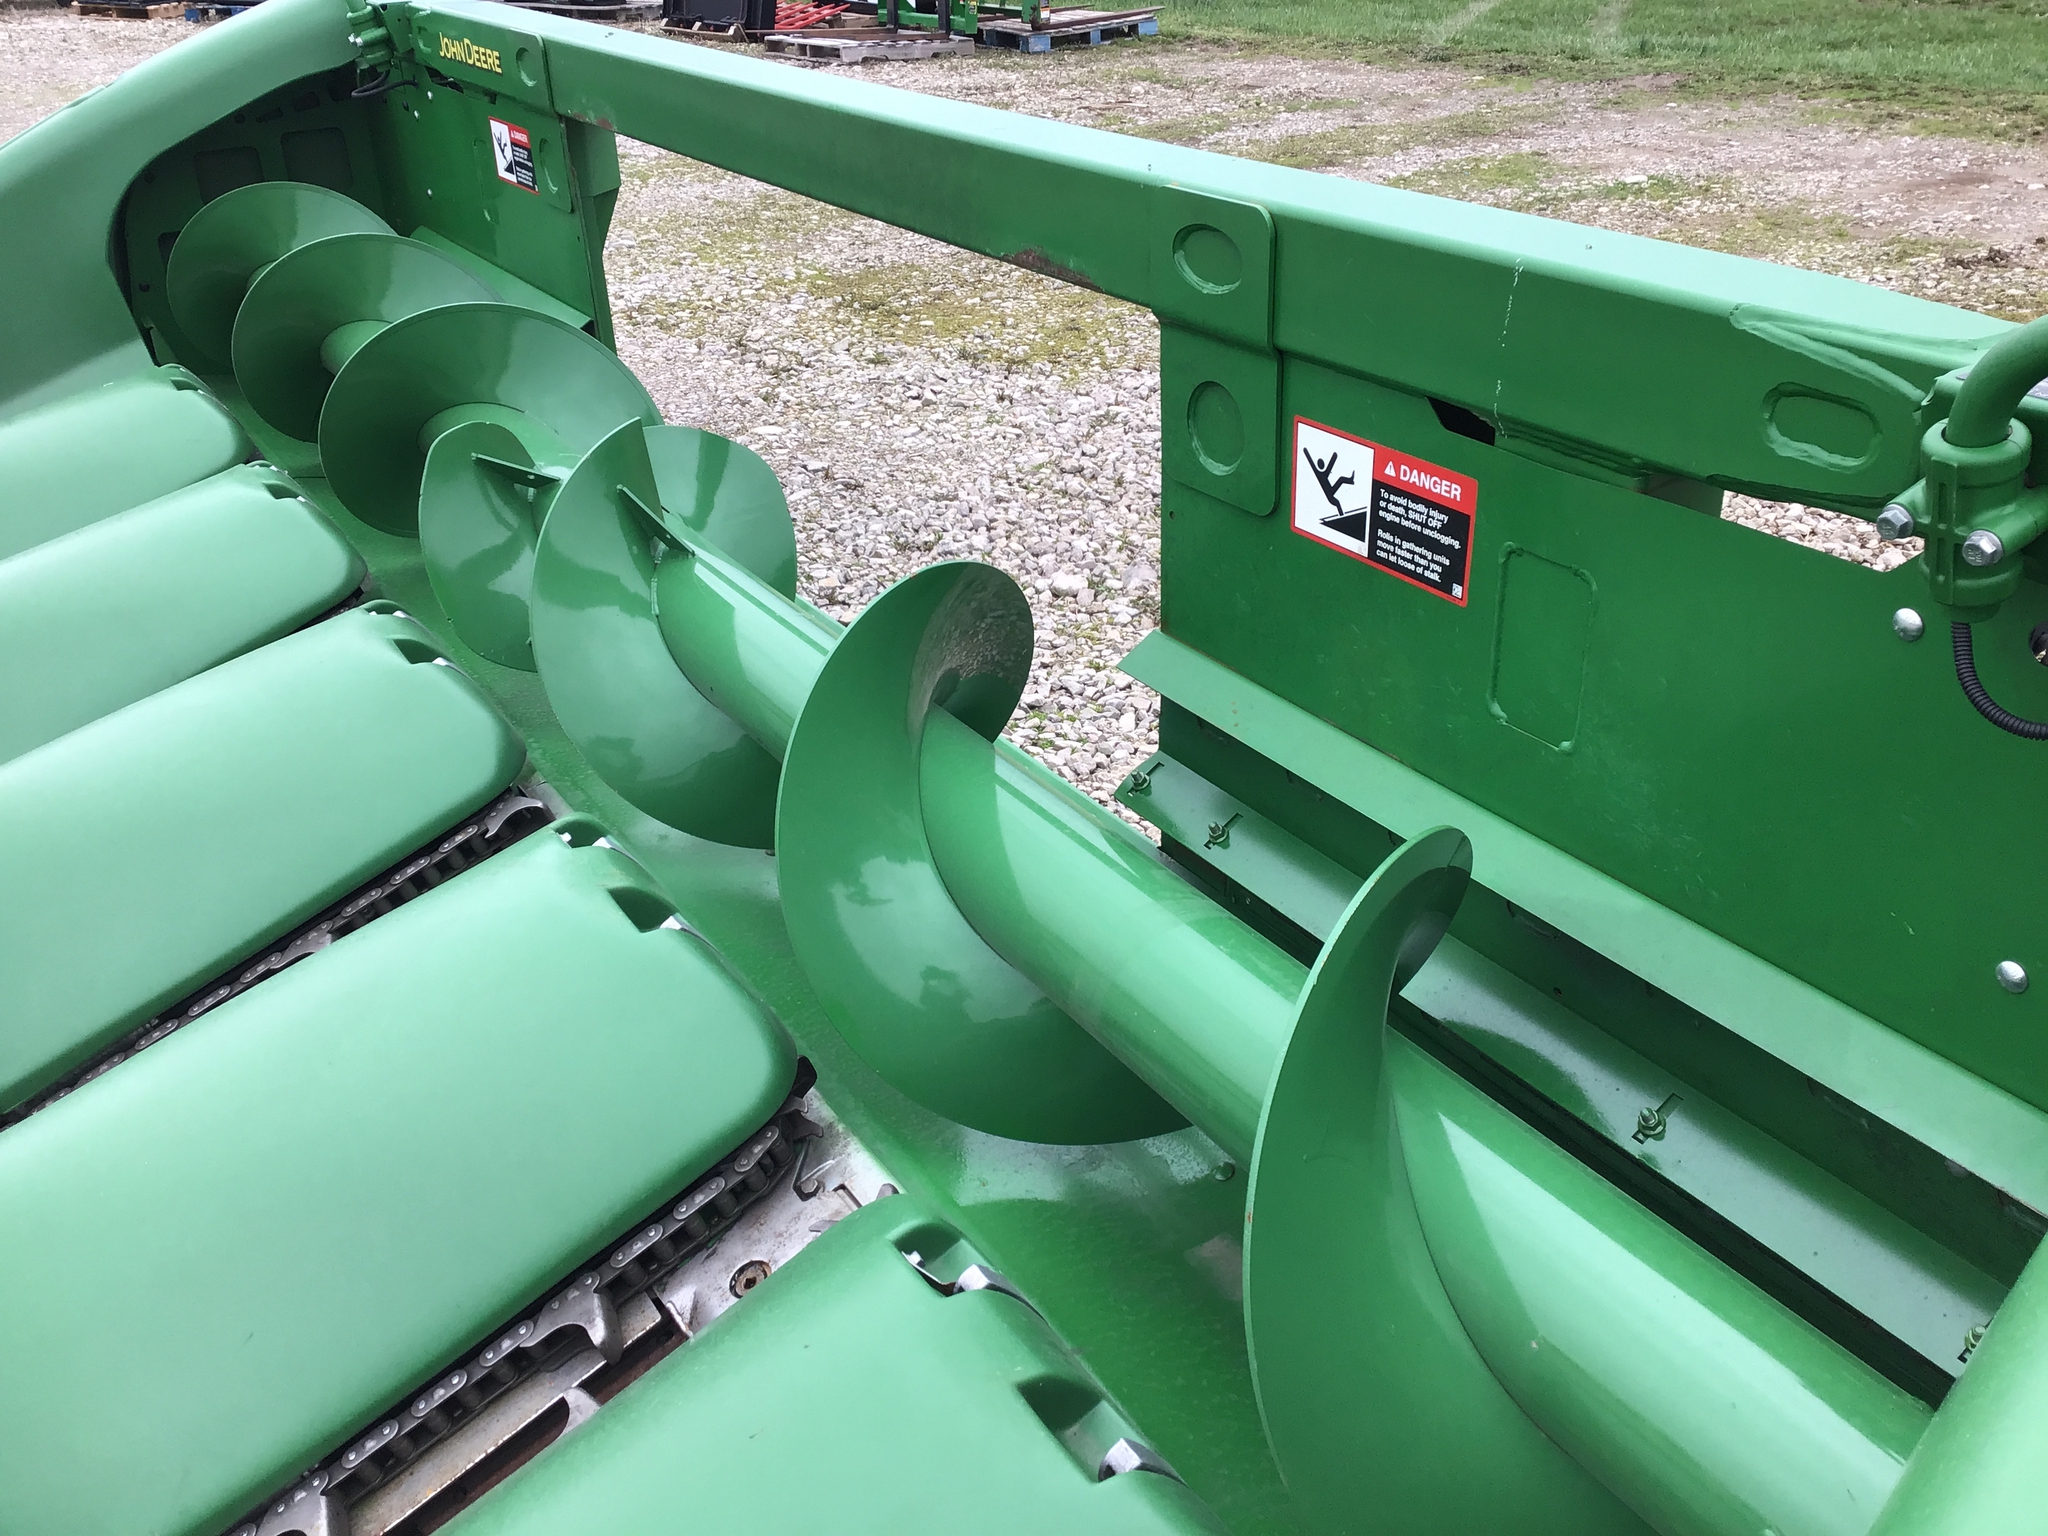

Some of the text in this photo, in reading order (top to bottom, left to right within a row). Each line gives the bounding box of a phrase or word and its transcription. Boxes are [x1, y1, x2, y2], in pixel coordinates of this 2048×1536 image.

[1400, 464, 1462, 502] DANGER
[1379, 500, 1443, 530] or death, SHUT OFF
[1380, 488, 1449, 524] To avoid bodily injury
[1377, 528, 1450, 566] Rolls in gathering units
[1378, 510, 1461, 550] engine before unclogging.
[1376, 540, 1442, 573] move faster than you
[1376, 549, 1441, 583] can let loose of stalk.
